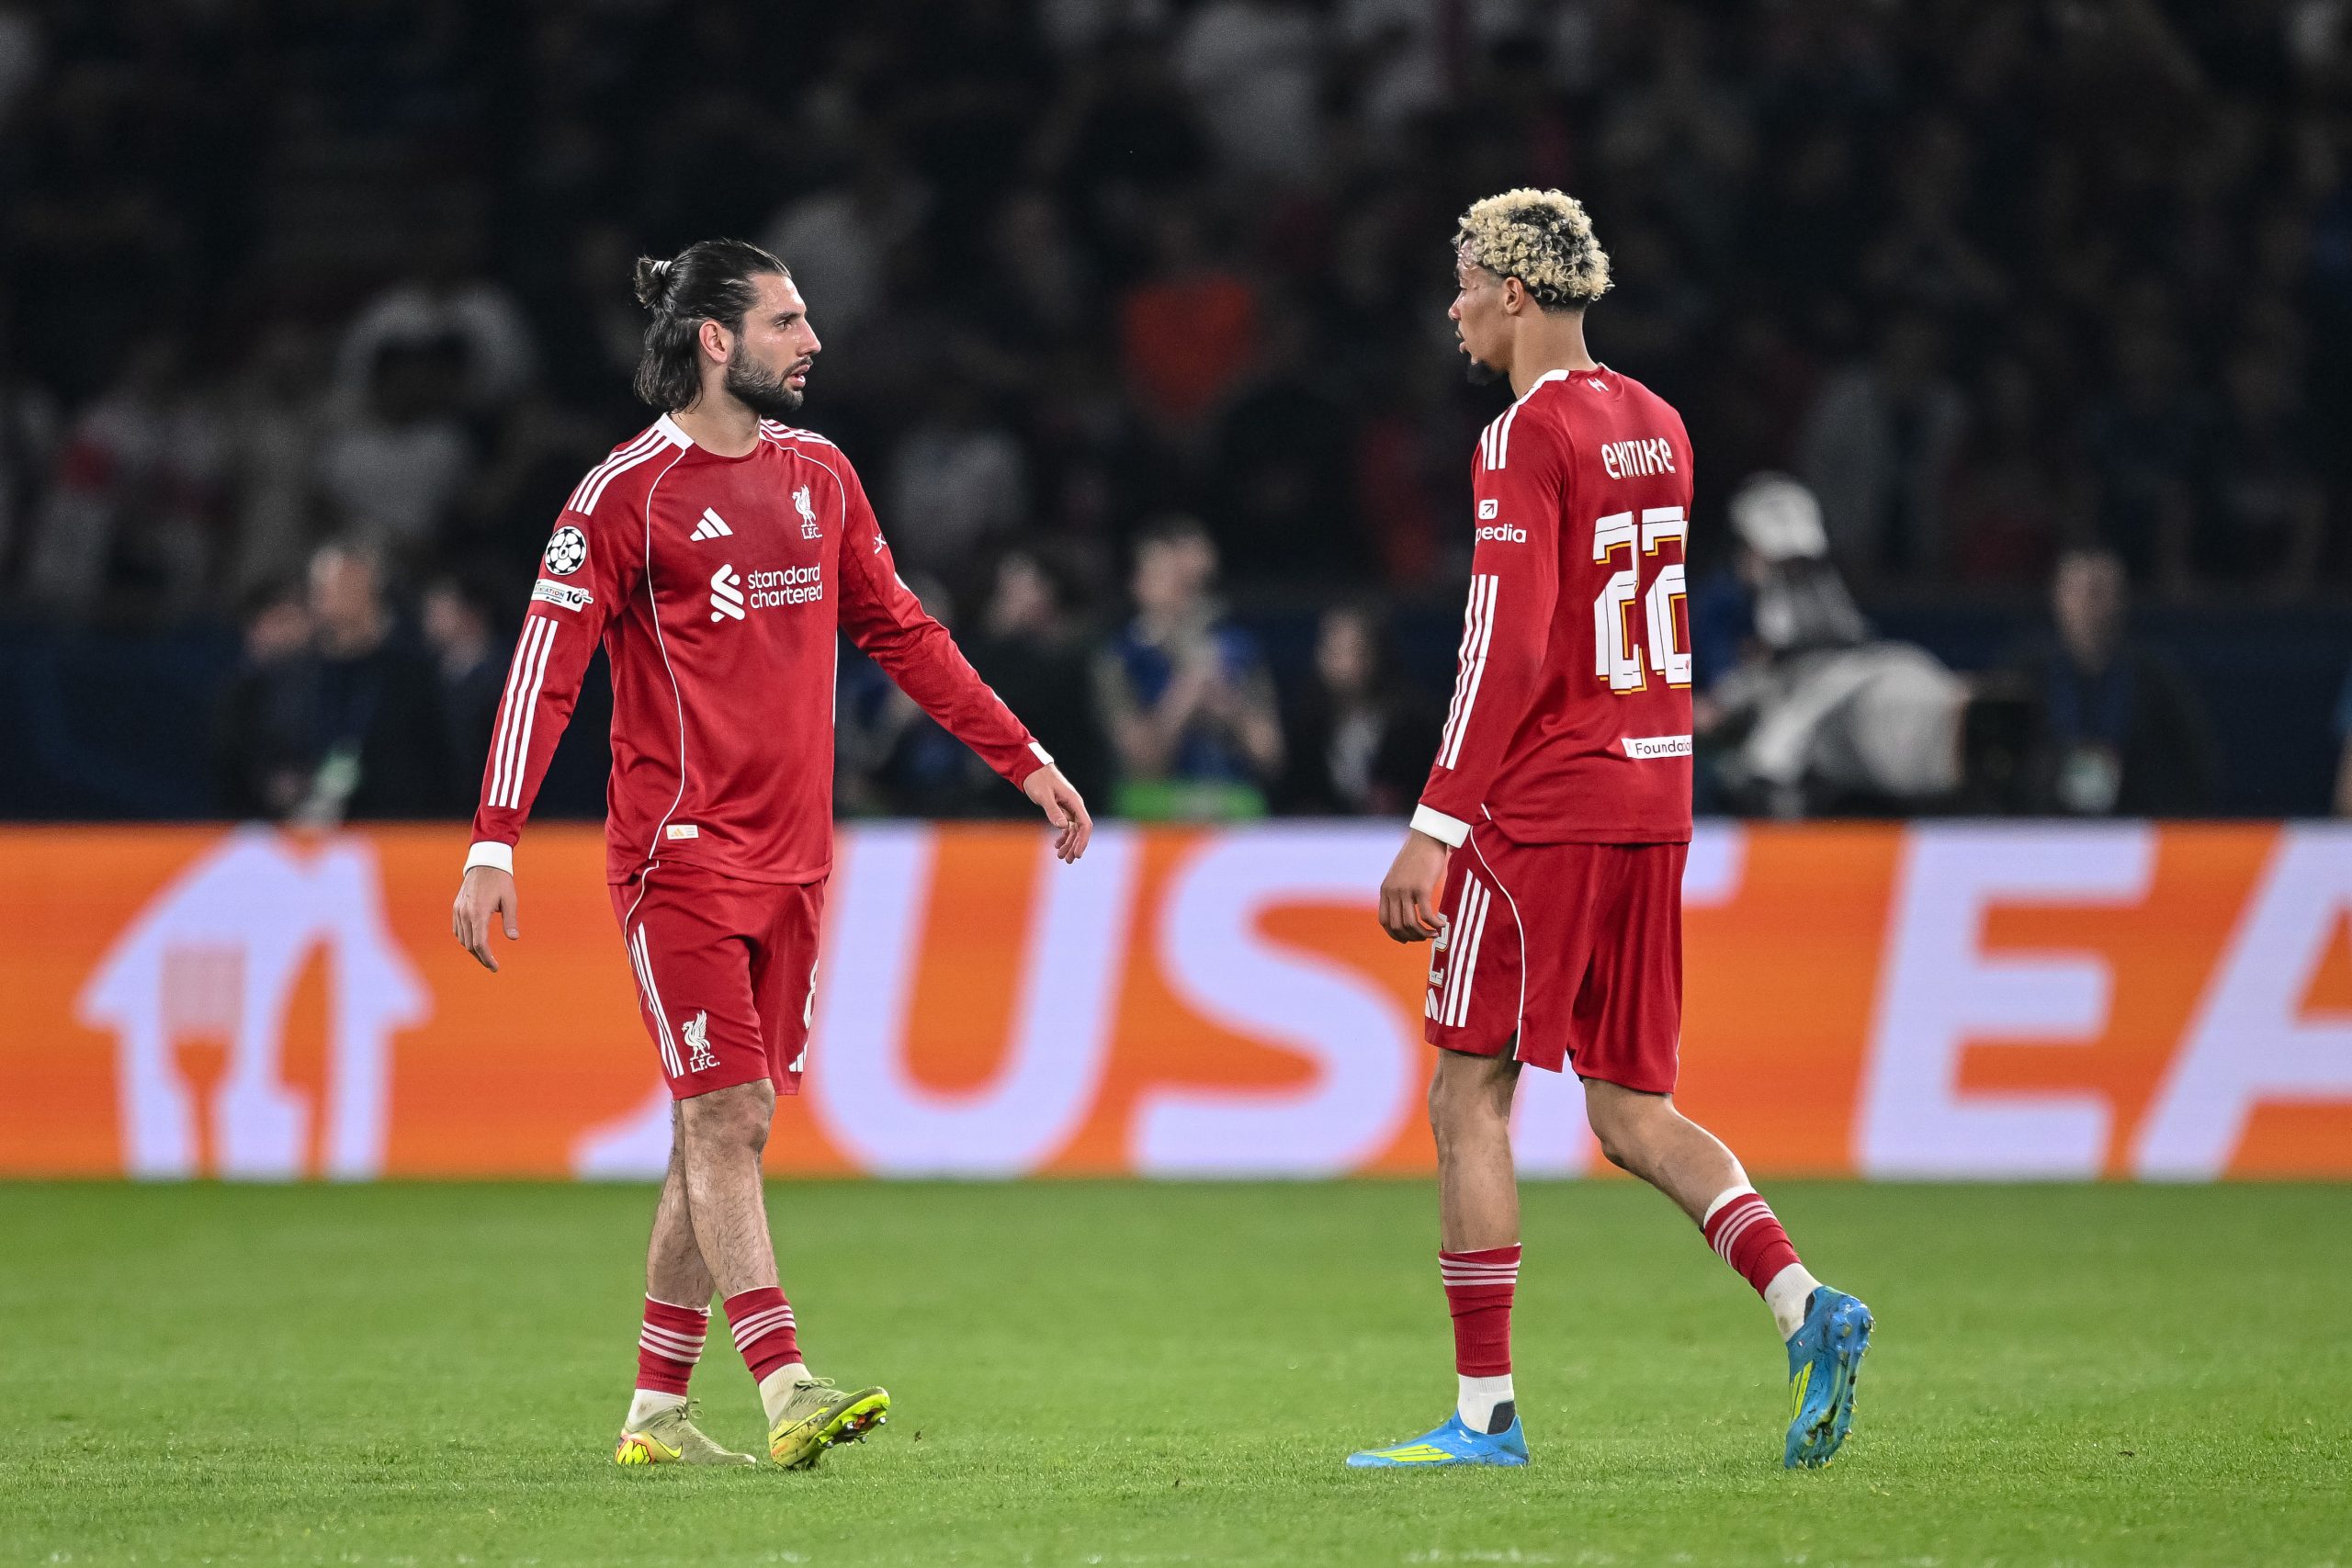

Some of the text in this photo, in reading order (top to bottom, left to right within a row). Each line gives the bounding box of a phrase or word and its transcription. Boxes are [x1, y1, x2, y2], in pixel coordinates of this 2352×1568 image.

[747, 561, 820, 589] standard
[750, 581, 823, 609] chartered
[1593, 506, 1691, 694] 22
